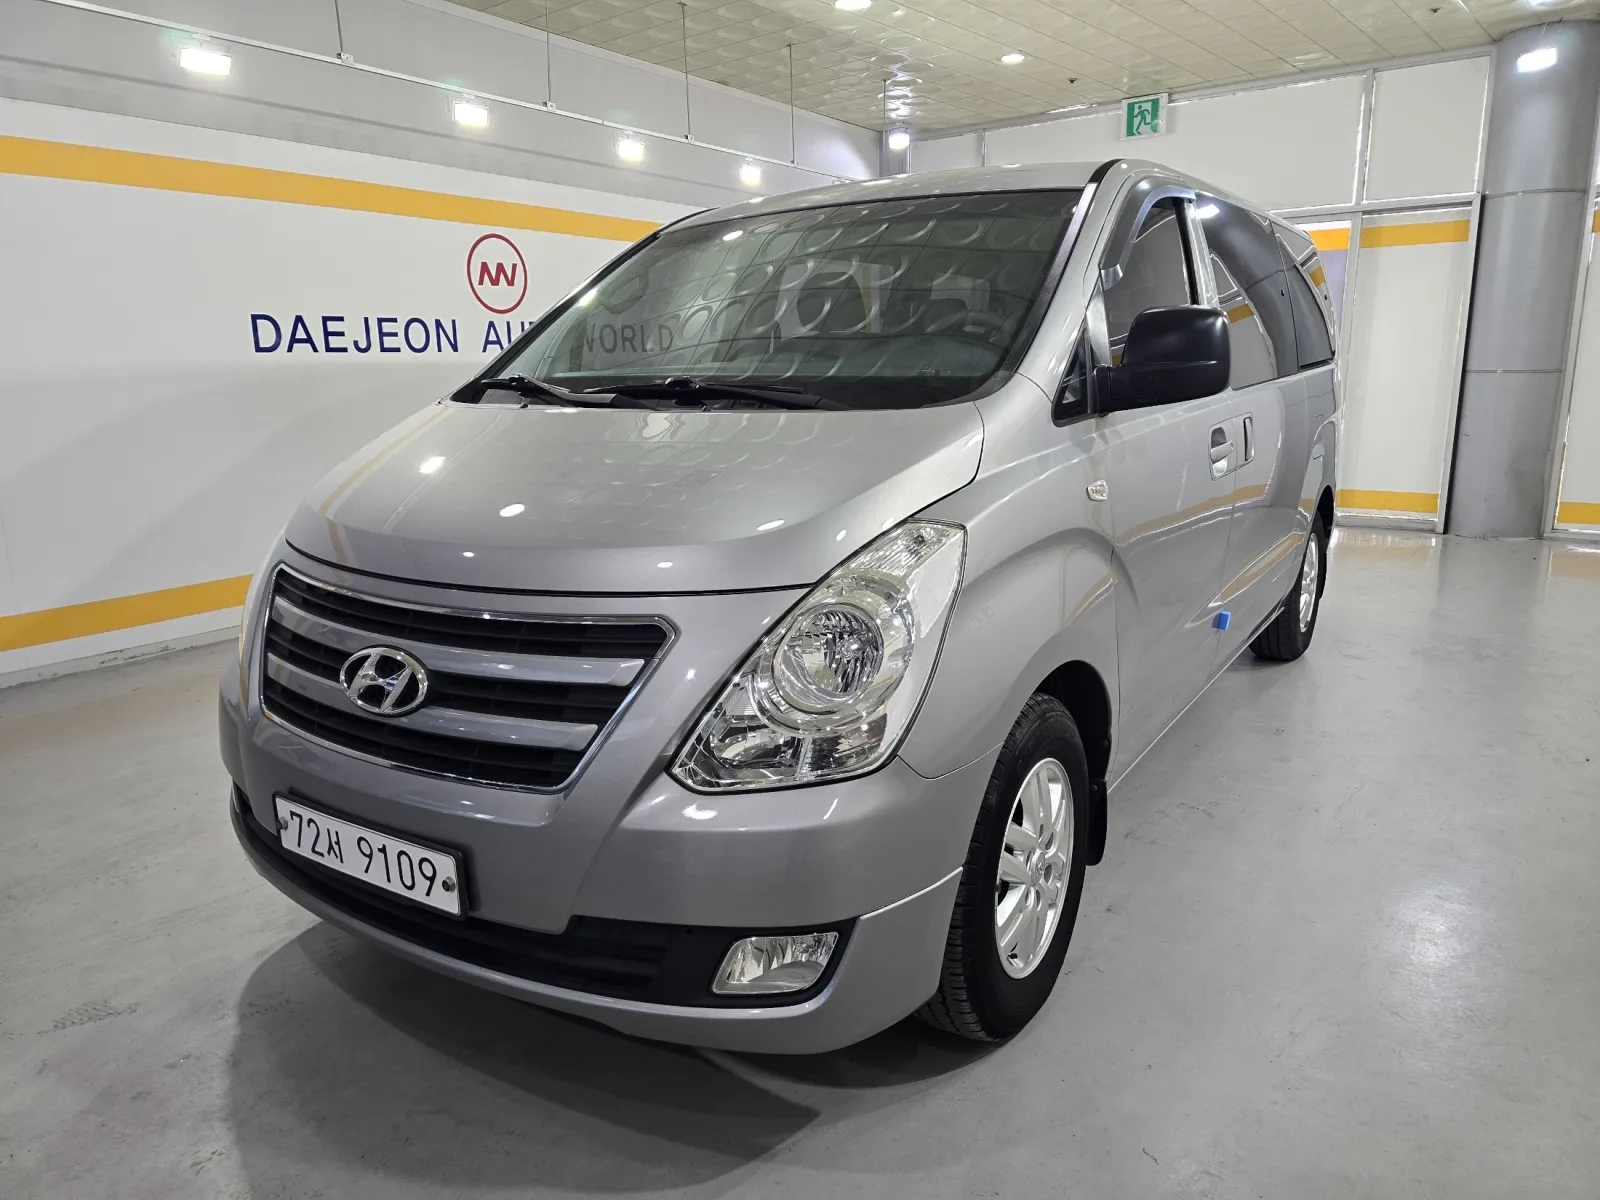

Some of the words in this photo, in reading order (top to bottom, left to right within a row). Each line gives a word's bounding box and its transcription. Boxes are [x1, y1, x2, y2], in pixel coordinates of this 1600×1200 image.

[250, 313, 459, 353] DAEJEON
[482, 320, 534, 353] AU
[290, 810, 344, 864] 72서
[357, 836, 437, 897] 9109
